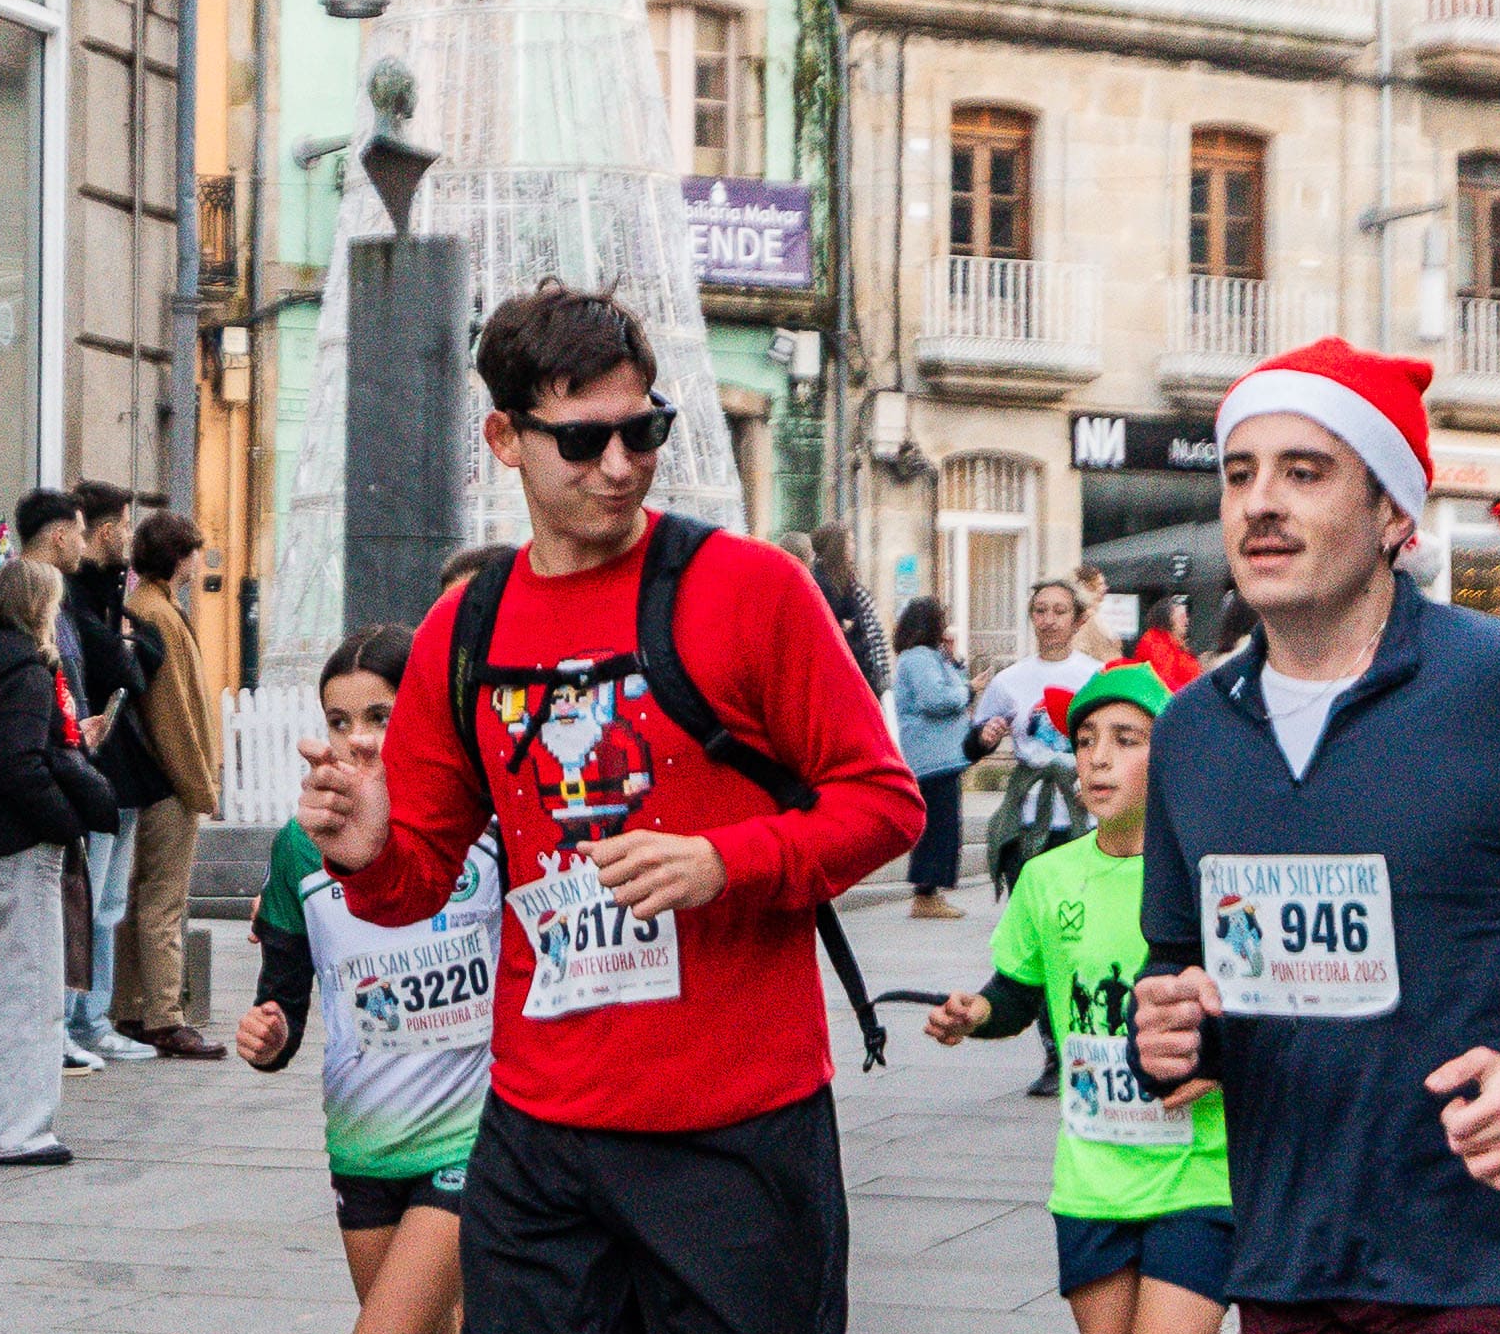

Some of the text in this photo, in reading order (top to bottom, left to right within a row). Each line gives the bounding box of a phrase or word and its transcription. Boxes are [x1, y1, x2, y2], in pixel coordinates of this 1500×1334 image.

[688, 223, 785, 264] ENDE
[550, 877, 582, 908] SAN
[1243, 863, 1281, 895] SAN
[1286, 863, 1380, 896] SILVESTRE
[1280, 901, 1370, 954] 946
[378, 950, 411, 976] SAN
[413, 930, 483, 968] SILVESTRE
[640, 946, 670, 968] 2025
[400, 956, 490, 1013] 3220
[1270, 959, 1388, 983] PONTEVEDRA 2025
[406, 1005, 472, 1032] PONTEVEDRA
